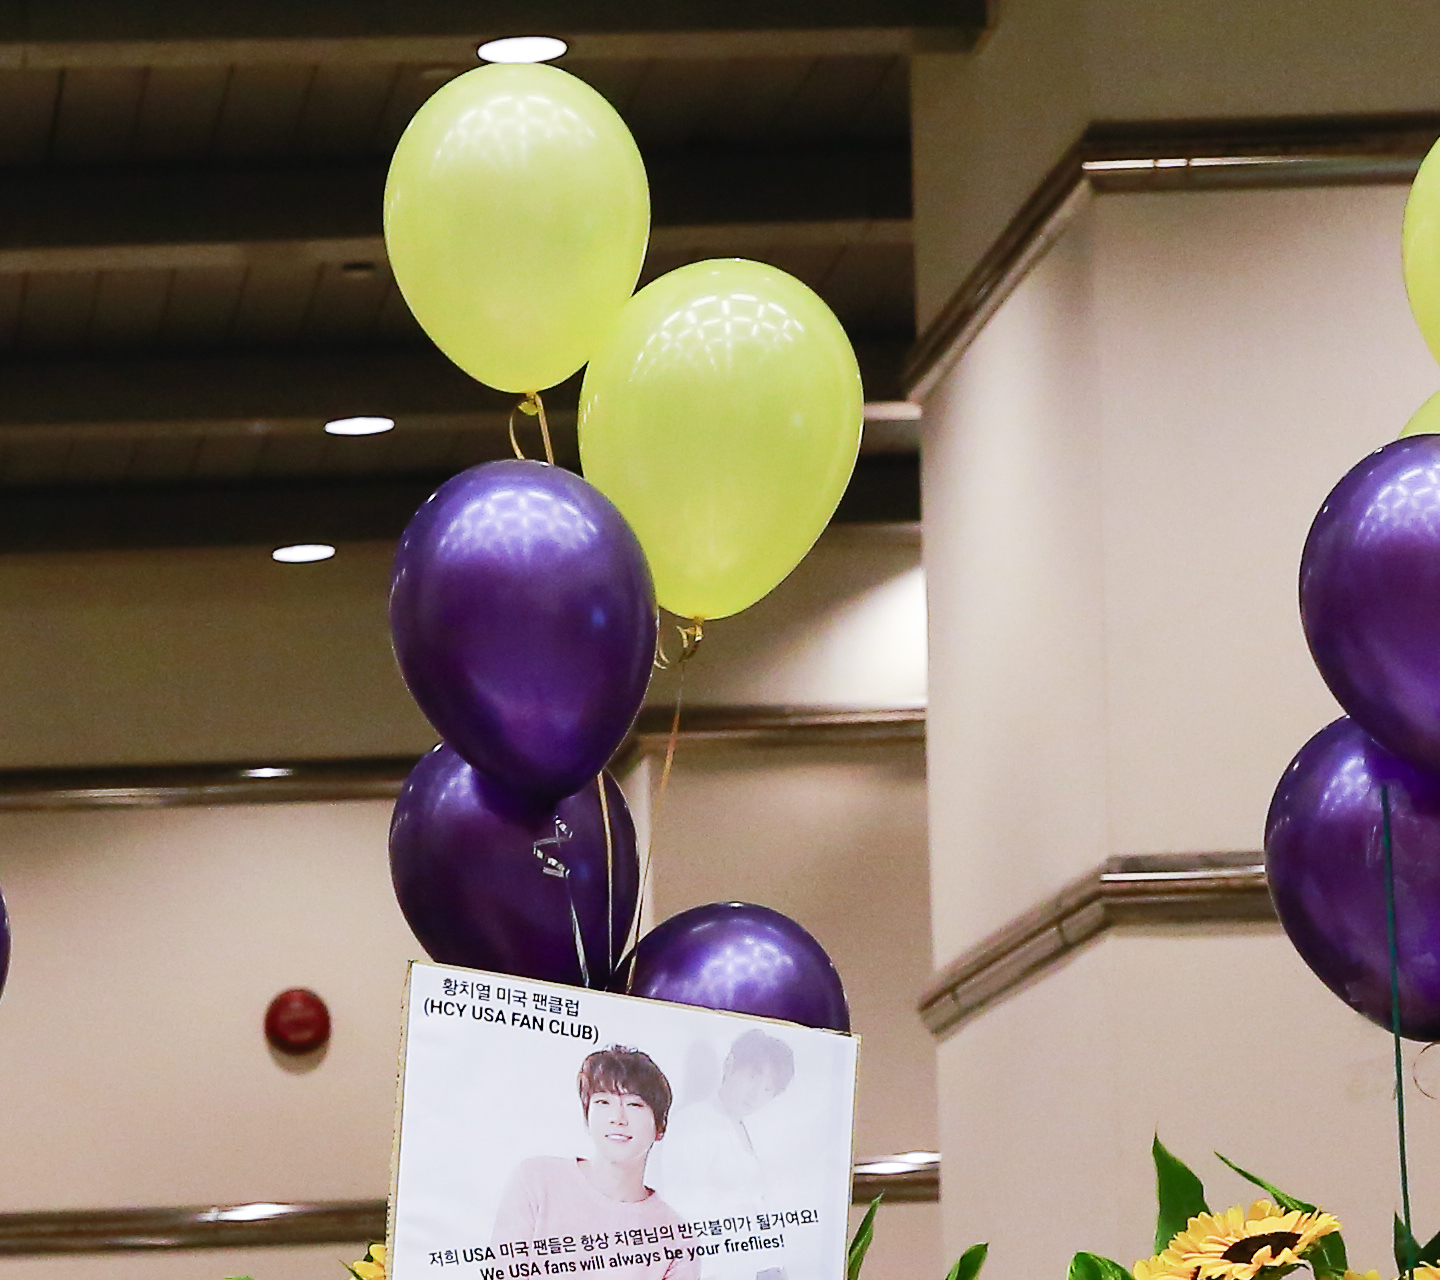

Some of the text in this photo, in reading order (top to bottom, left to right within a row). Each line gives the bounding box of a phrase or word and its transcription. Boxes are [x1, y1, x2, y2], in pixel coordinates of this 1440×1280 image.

[442, 977, 580, 1018] 황치열 미국 팬클럽
[423, 997, 600, 1045] (HCY USA FAN CLUB)
[429, 1248, 458, 1268] 저희
[463, 1245, 495, 1264] USA
[499, 1240, 529, 1260] 미국
[533, 1235, 576, 1257] 팬들은
[580, 1230, 610, 1252] 항상
[614, 1222, 675, 1248] 치열님의
[508, 1261, 541, 1279] USA
[544, 1258, 576, 1276] fans
[580, 1253, 605, 1271] will
[608, 1248, 661, 1269] always
[665, 1244, 683, 1262] be
[686, 1240, 720, 1262] your
[723, 1232, 785, 1255] fireflies!
